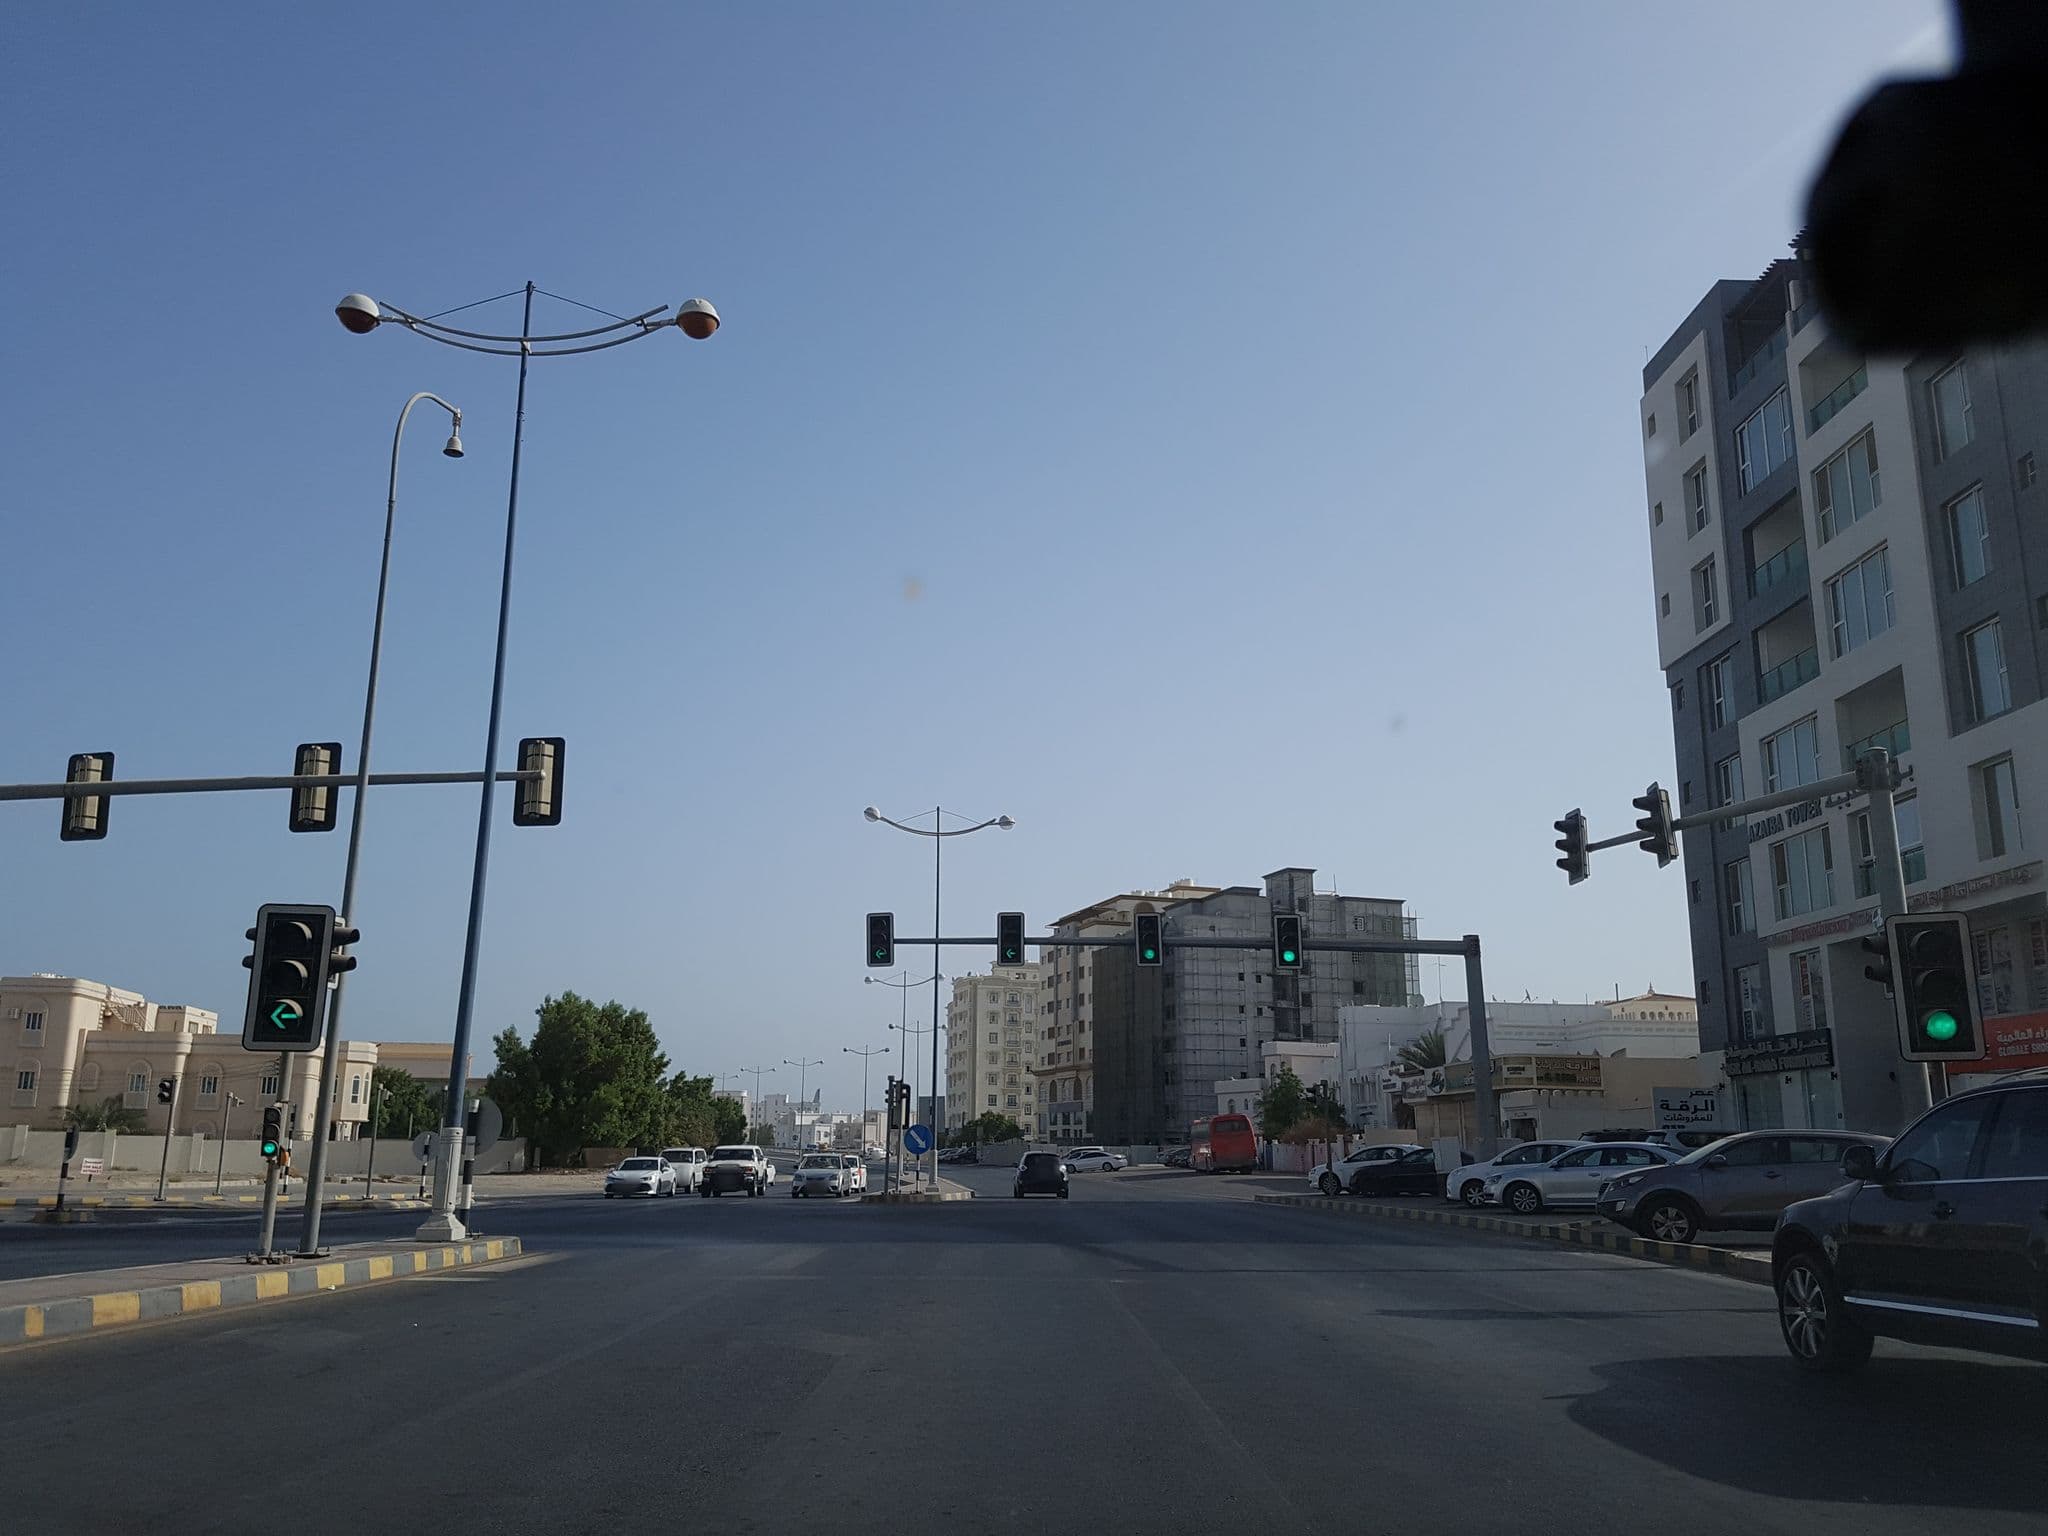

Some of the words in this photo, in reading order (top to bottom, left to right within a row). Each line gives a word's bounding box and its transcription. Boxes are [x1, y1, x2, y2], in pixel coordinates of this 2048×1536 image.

[1750, 812, 1785, 843] AZAIBA
[1689, 1090, 1714, 1098] عصر
[1660, 1099, 1715, 1114] الرقة
